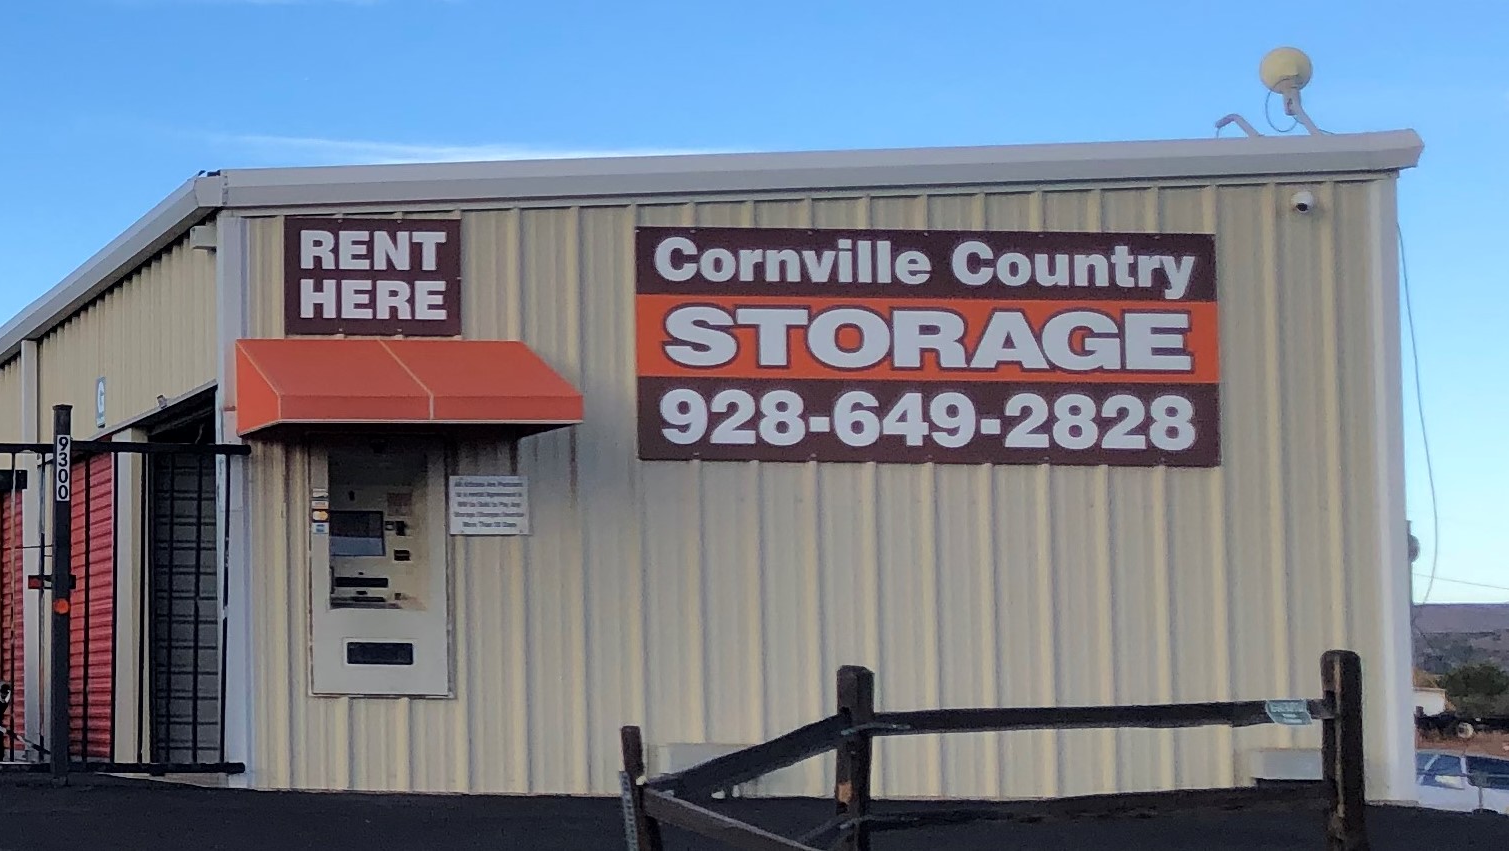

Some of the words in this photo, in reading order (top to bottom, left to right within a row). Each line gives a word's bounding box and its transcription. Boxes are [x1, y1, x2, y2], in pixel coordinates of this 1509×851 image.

[299, 229, 447, 271] RENT
[653, 236, 932, 286] Cornville
[951, 240, 1196, 300] Country
[299, 278, 448, 320] HERE
[662, 304, 1195, 373] STORAGE
[659, 388, 1197, 452] 928-649-2828
[57, 436, 70, 500] 9300
